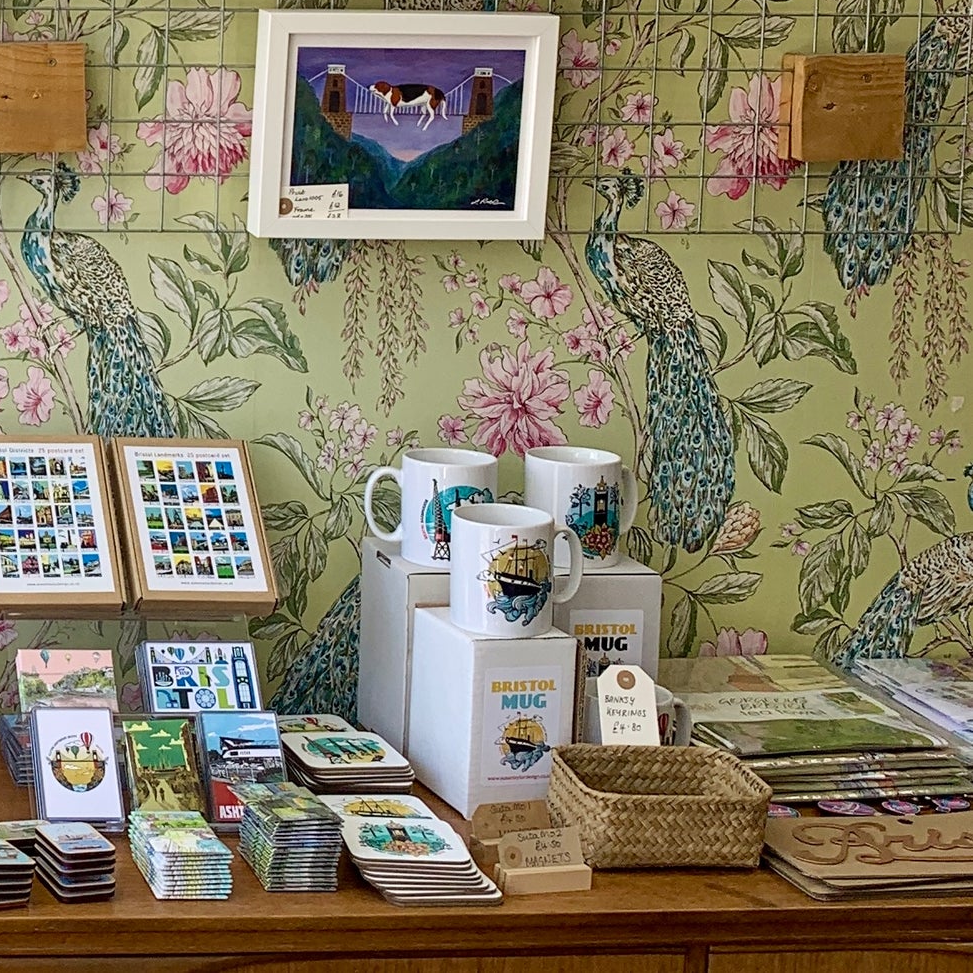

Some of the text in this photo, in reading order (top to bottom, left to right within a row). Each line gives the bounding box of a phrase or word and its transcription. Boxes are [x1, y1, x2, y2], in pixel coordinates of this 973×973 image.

[574, 624, 637, 635] BRISTOL
[583, 636, 628, 651] MUG
[491, 679, 557, 693] BRISTOL
[501, 693, 547, 710] MUG
[604, 695, 635, 706] BANKSY
[606, 709, 647, 718] KEYRINGS
[525, 851, 572, 867] MAGNETS
